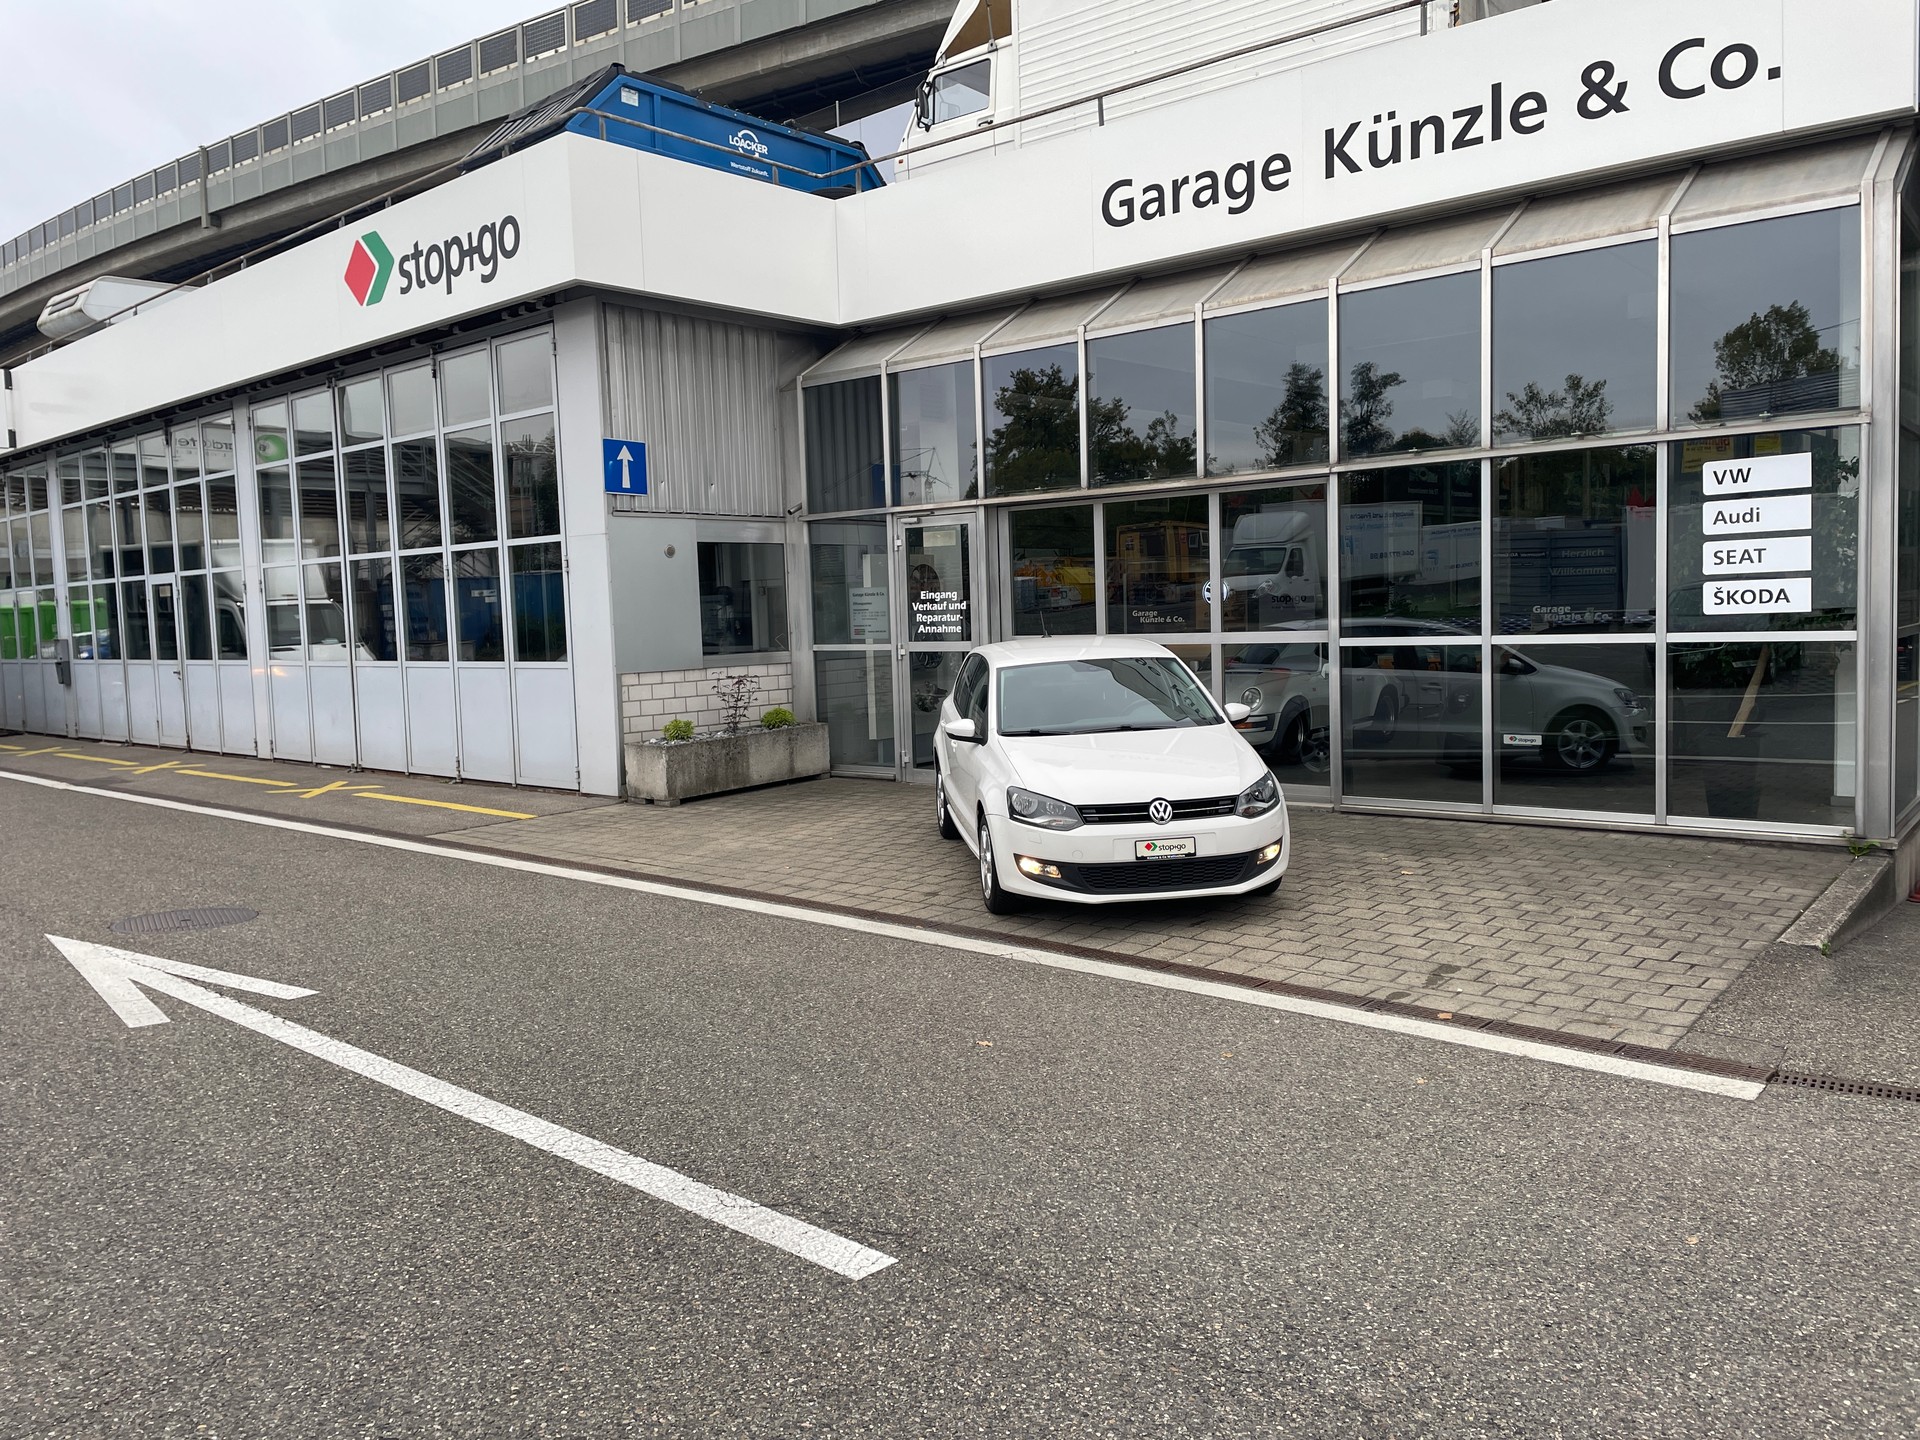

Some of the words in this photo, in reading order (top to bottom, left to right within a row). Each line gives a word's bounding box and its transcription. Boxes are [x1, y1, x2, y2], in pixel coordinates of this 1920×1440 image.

[1101, 154, 1292, 228] Garage
[1324, 82, 1548, 180] Künzle
[1576, 60, 1631, 120] &
[1658, 38, 1781, 100] Co.
[728, 134, 768, 155] LOACKER
[398, 215, 521, 296] stop+go
[1712, 467, 1752, 486] VW
[1712, 506, 1761, 525] Audi
[1561, 548, 1605, 558] Herzlich
[1713, 548, 1767, 566] SEAT
[1550, 566, 1617, 576] Willkommen
[920, 590, 958, 601] Eingang
[1713, 586, 1791, 606] ŠKODA
[911, 602, 947, 611] Verkauf
[948, 601, 967, 610] und
[1532, 605, 1571, 615] Garage
[916, 613, 963, 624] Reparatur-
[1543, 612, 1582, 621] Künzle
[1594, 612, 1613, 620] Co.
[917, 624, 962, 634] Annahme
[1150, 799, 1172, 824] VW
[1158, 843, 1187, 852] stop+go
